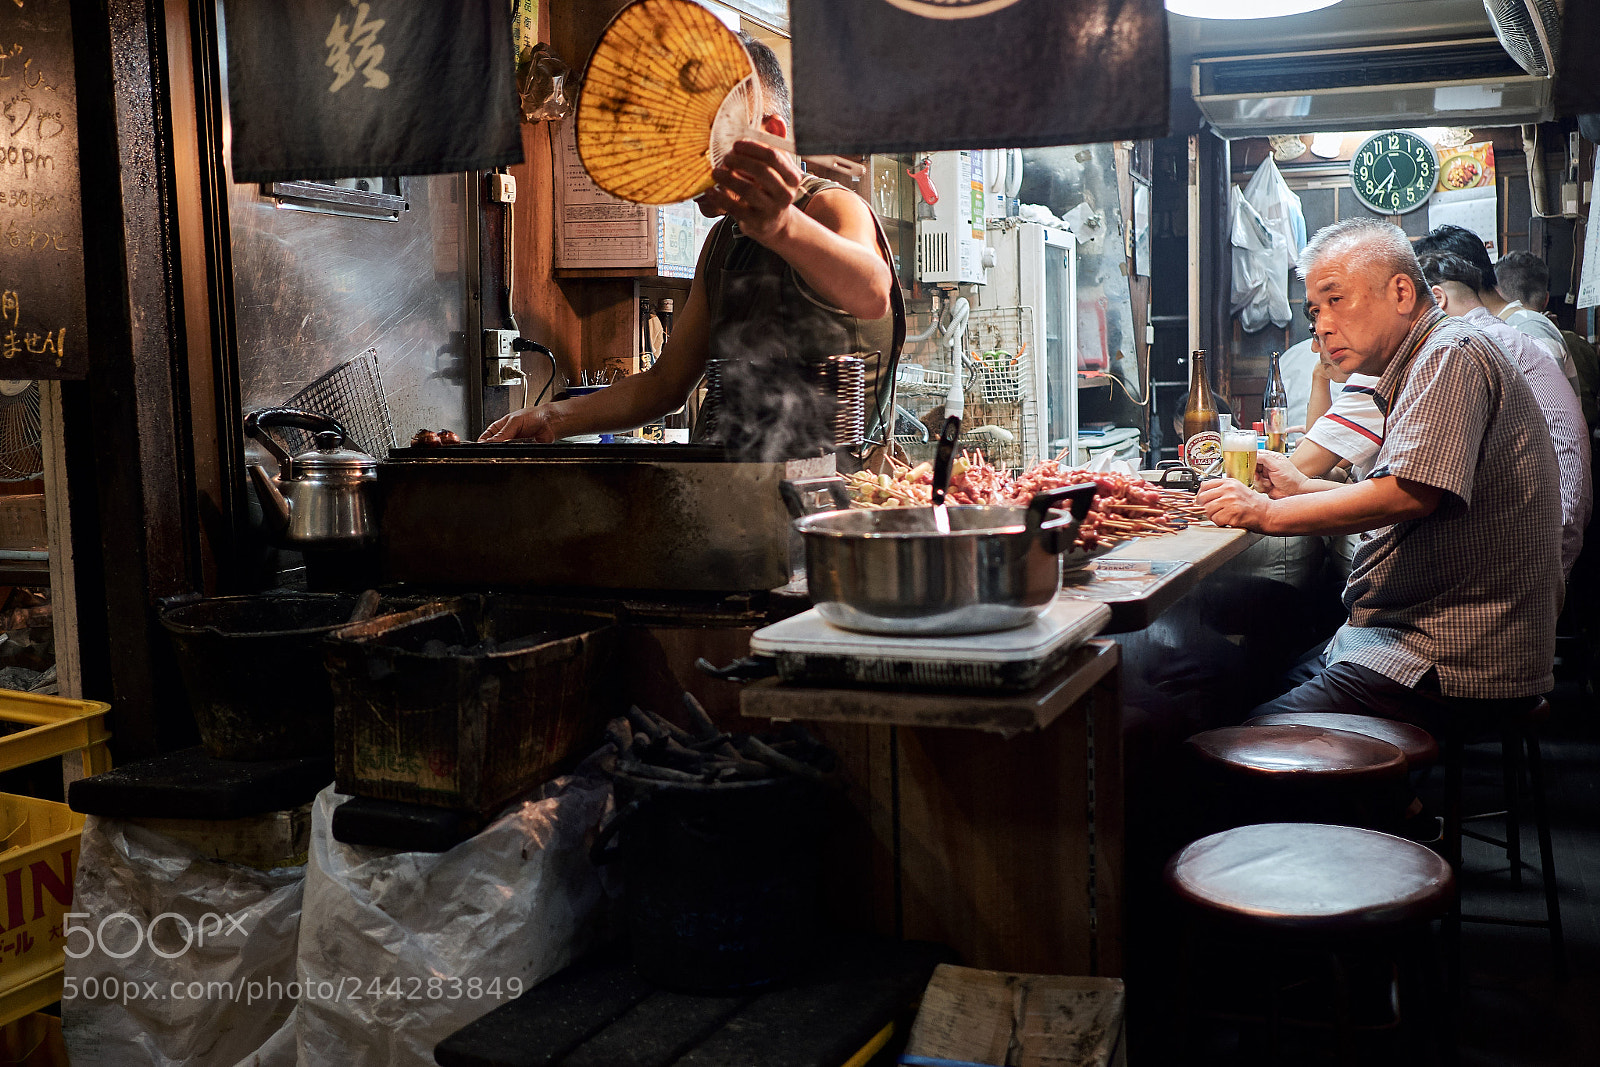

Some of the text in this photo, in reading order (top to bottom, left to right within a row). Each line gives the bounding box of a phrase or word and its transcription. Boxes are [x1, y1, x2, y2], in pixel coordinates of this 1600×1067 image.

[1373, 140, 1384, 155] 11
[1388, 135, 1400, 150] 12
[1406, 138, 1411, 153] 1
[1363, 151, 1374, 166] 10
[1416, 147, 1425, 162] 2
[1360, 166, 1369, 181] 9
[1420, 162, 1430, 177] 3
[1365, 180, 1374, 195] 8
[1416, 176, 1425, 191] 4
[1377, 189, 1385, 204] 7
[1391, 192, 1400, 207] 6
[1406, 187, 1415, 202] 5
[0, 849, 73, 934] IN
